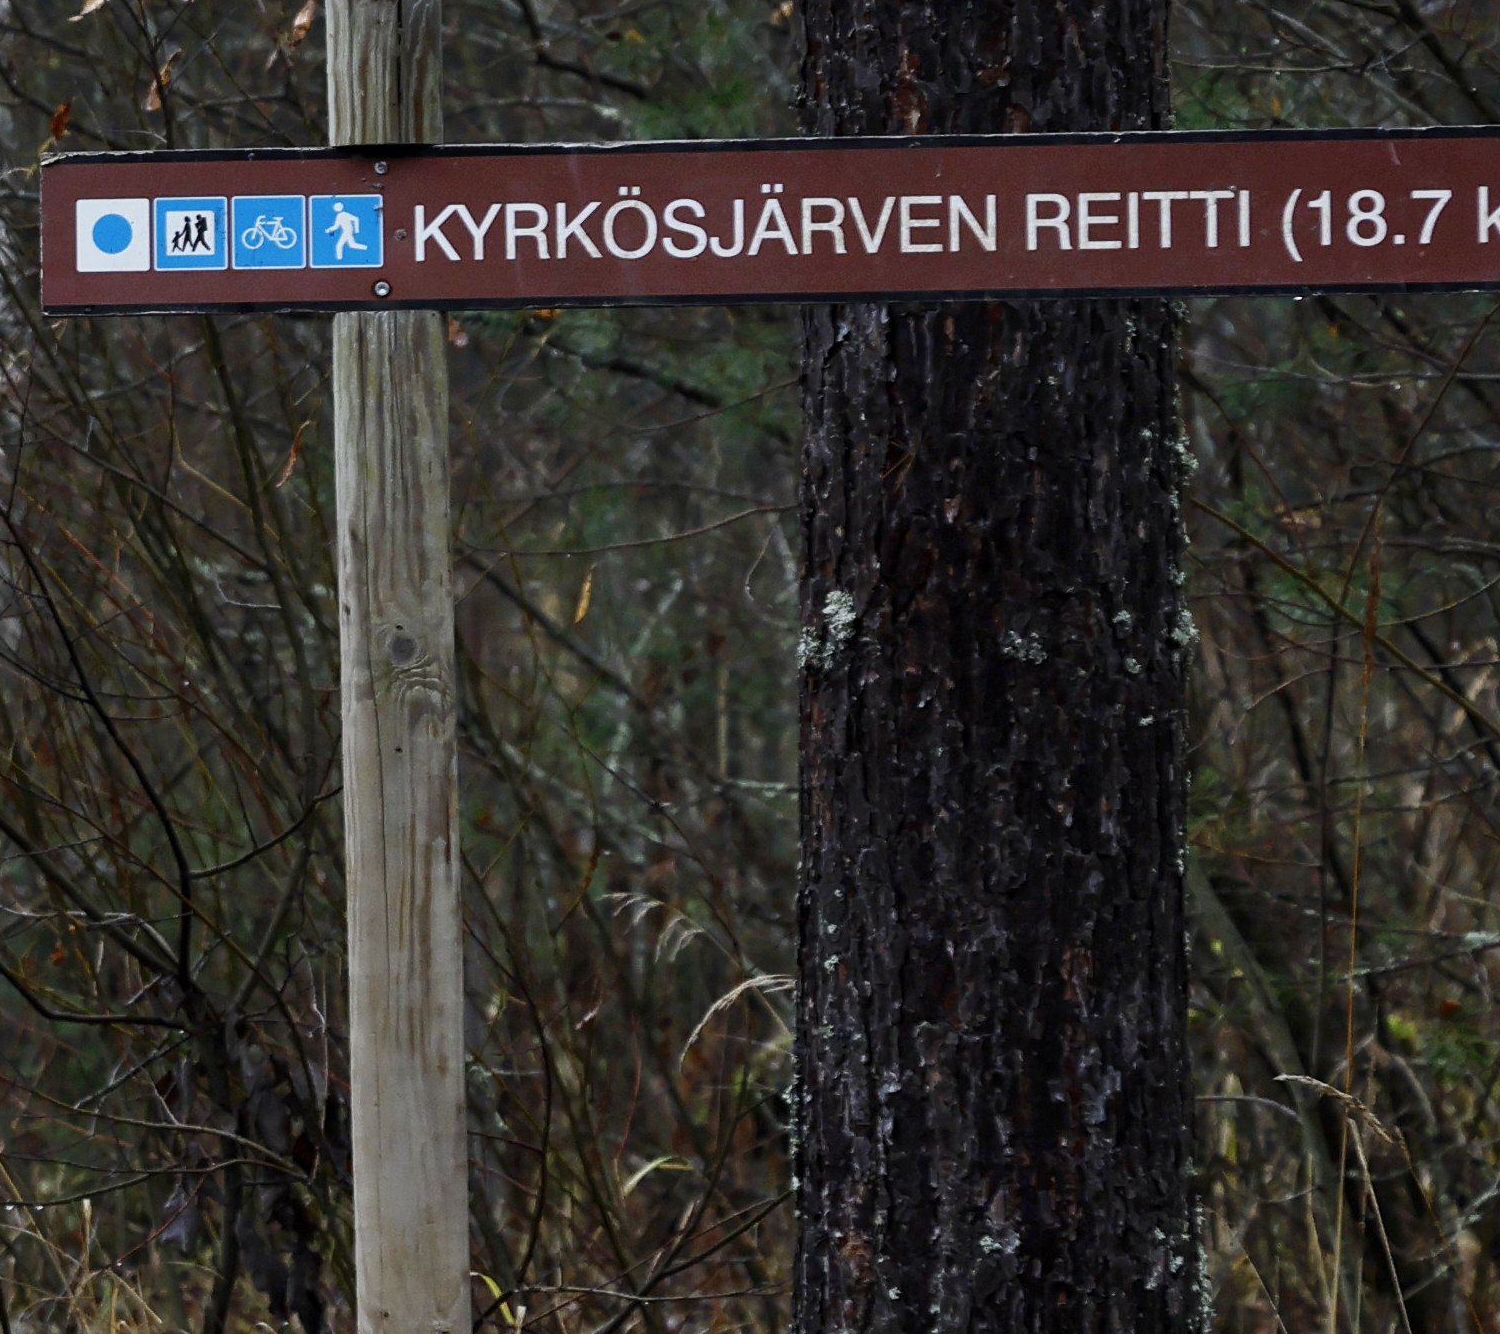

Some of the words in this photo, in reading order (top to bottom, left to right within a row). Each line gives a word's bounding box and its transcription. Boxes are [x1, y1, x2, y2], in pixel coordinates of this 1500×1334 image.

[412, 183, 998, 263] KYRKÖSJÄRVEN
[1025, 189, 1252, 252] REITTI
[1281, 187, 1454, 264] (18.7
